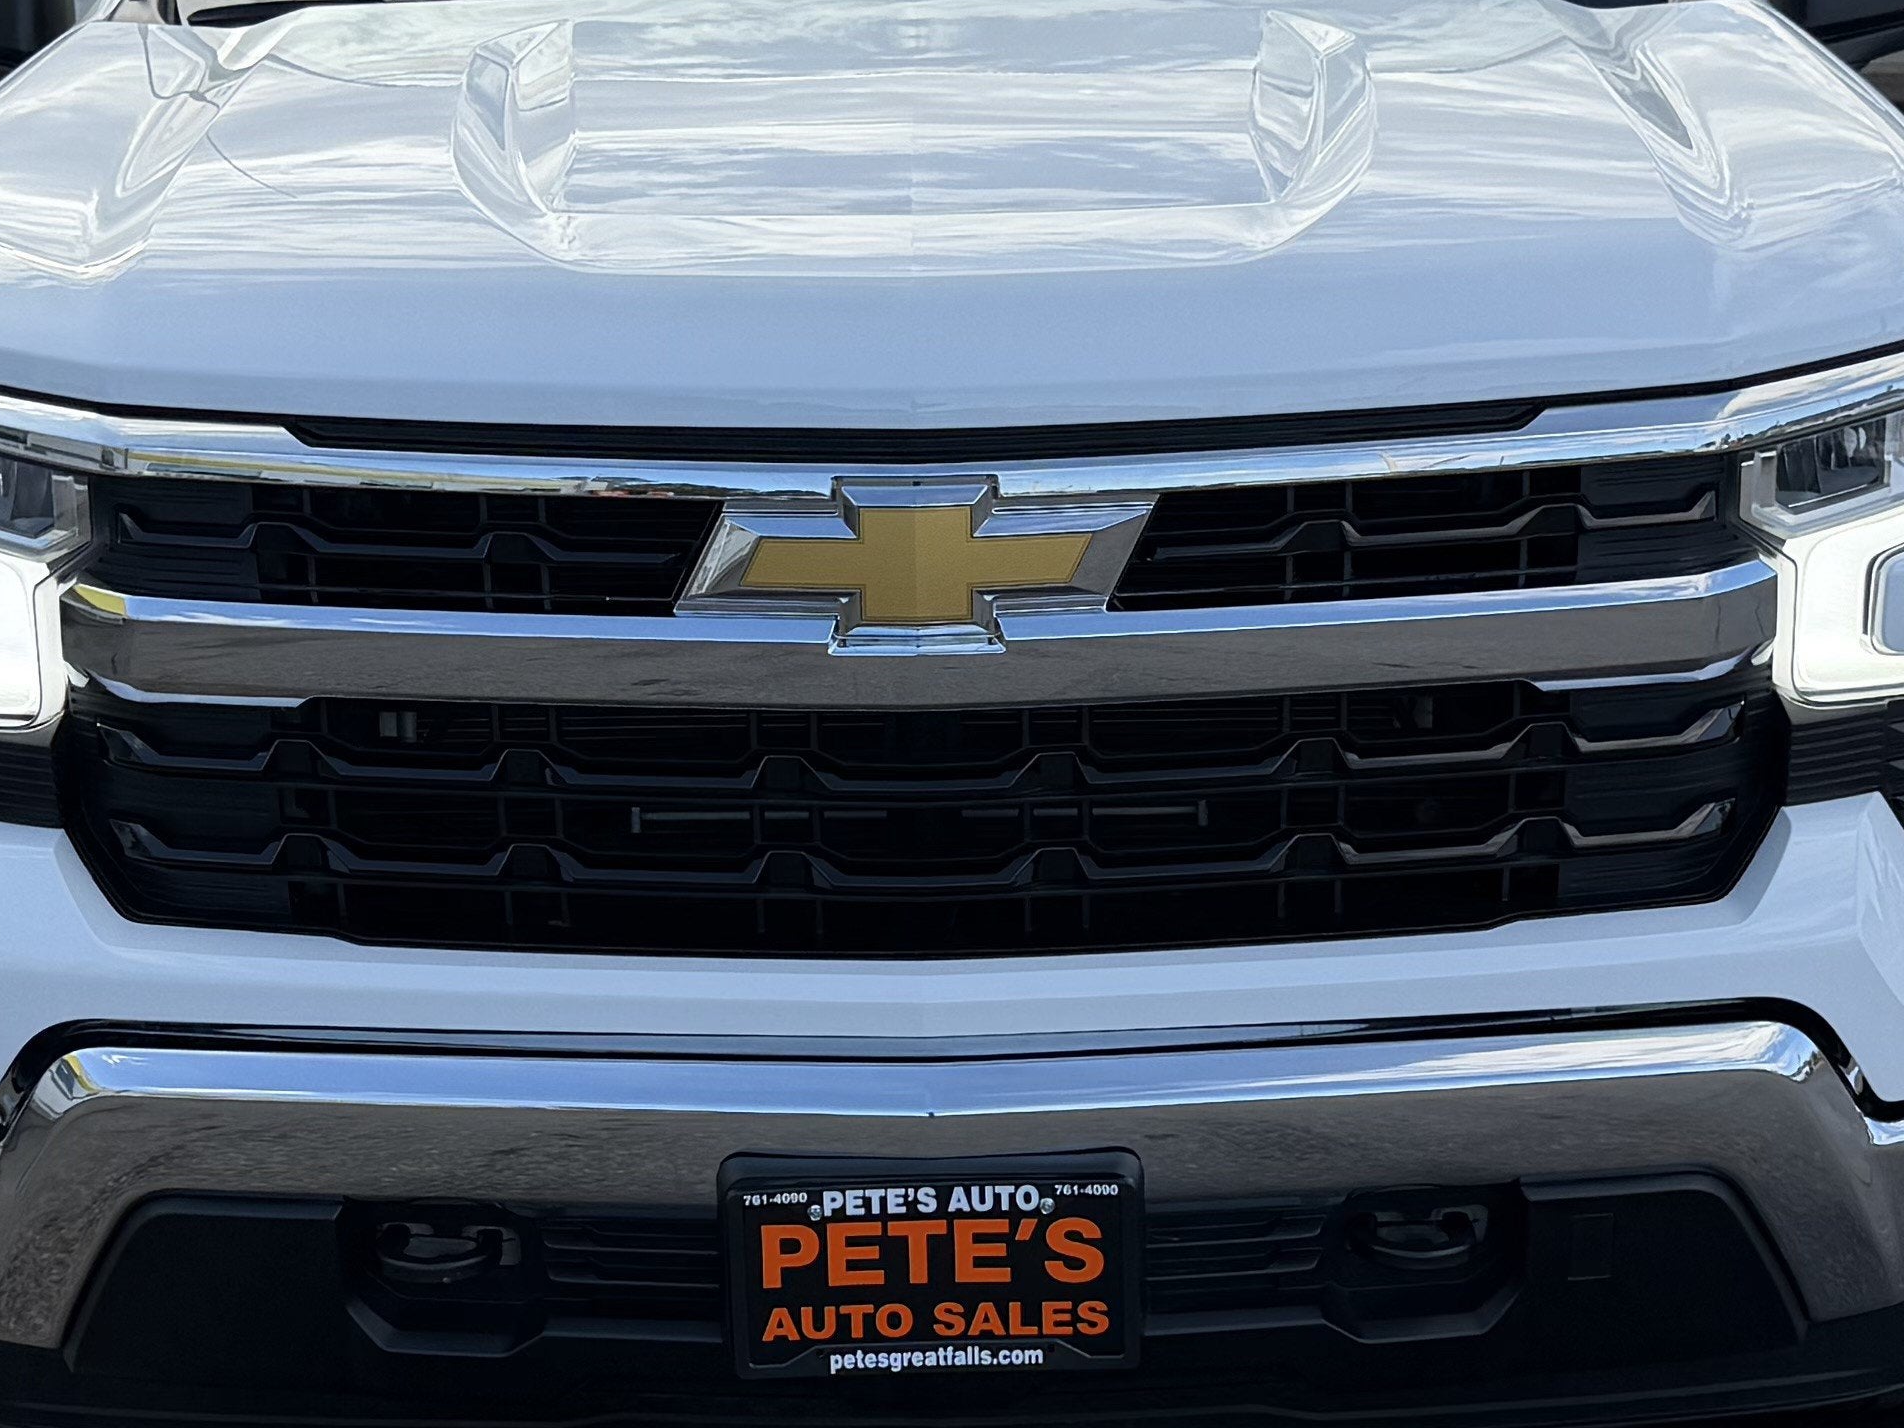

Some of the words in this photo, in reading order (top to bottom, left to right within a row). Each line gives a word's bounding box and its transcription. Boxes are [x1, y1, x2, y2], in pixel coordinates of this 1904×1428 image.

[822, 1186, 938, 1217] PETE'S
[947, 1184, 1040, 1213] AUTO
[760, 1217, 1105, 1289] PETE'S
[762, 1303, 913, 1342] AUTO
[933, 1300, 1109, 1336] SALES
[829, 1345, 1044, 1375] petesgreatfalls.com
